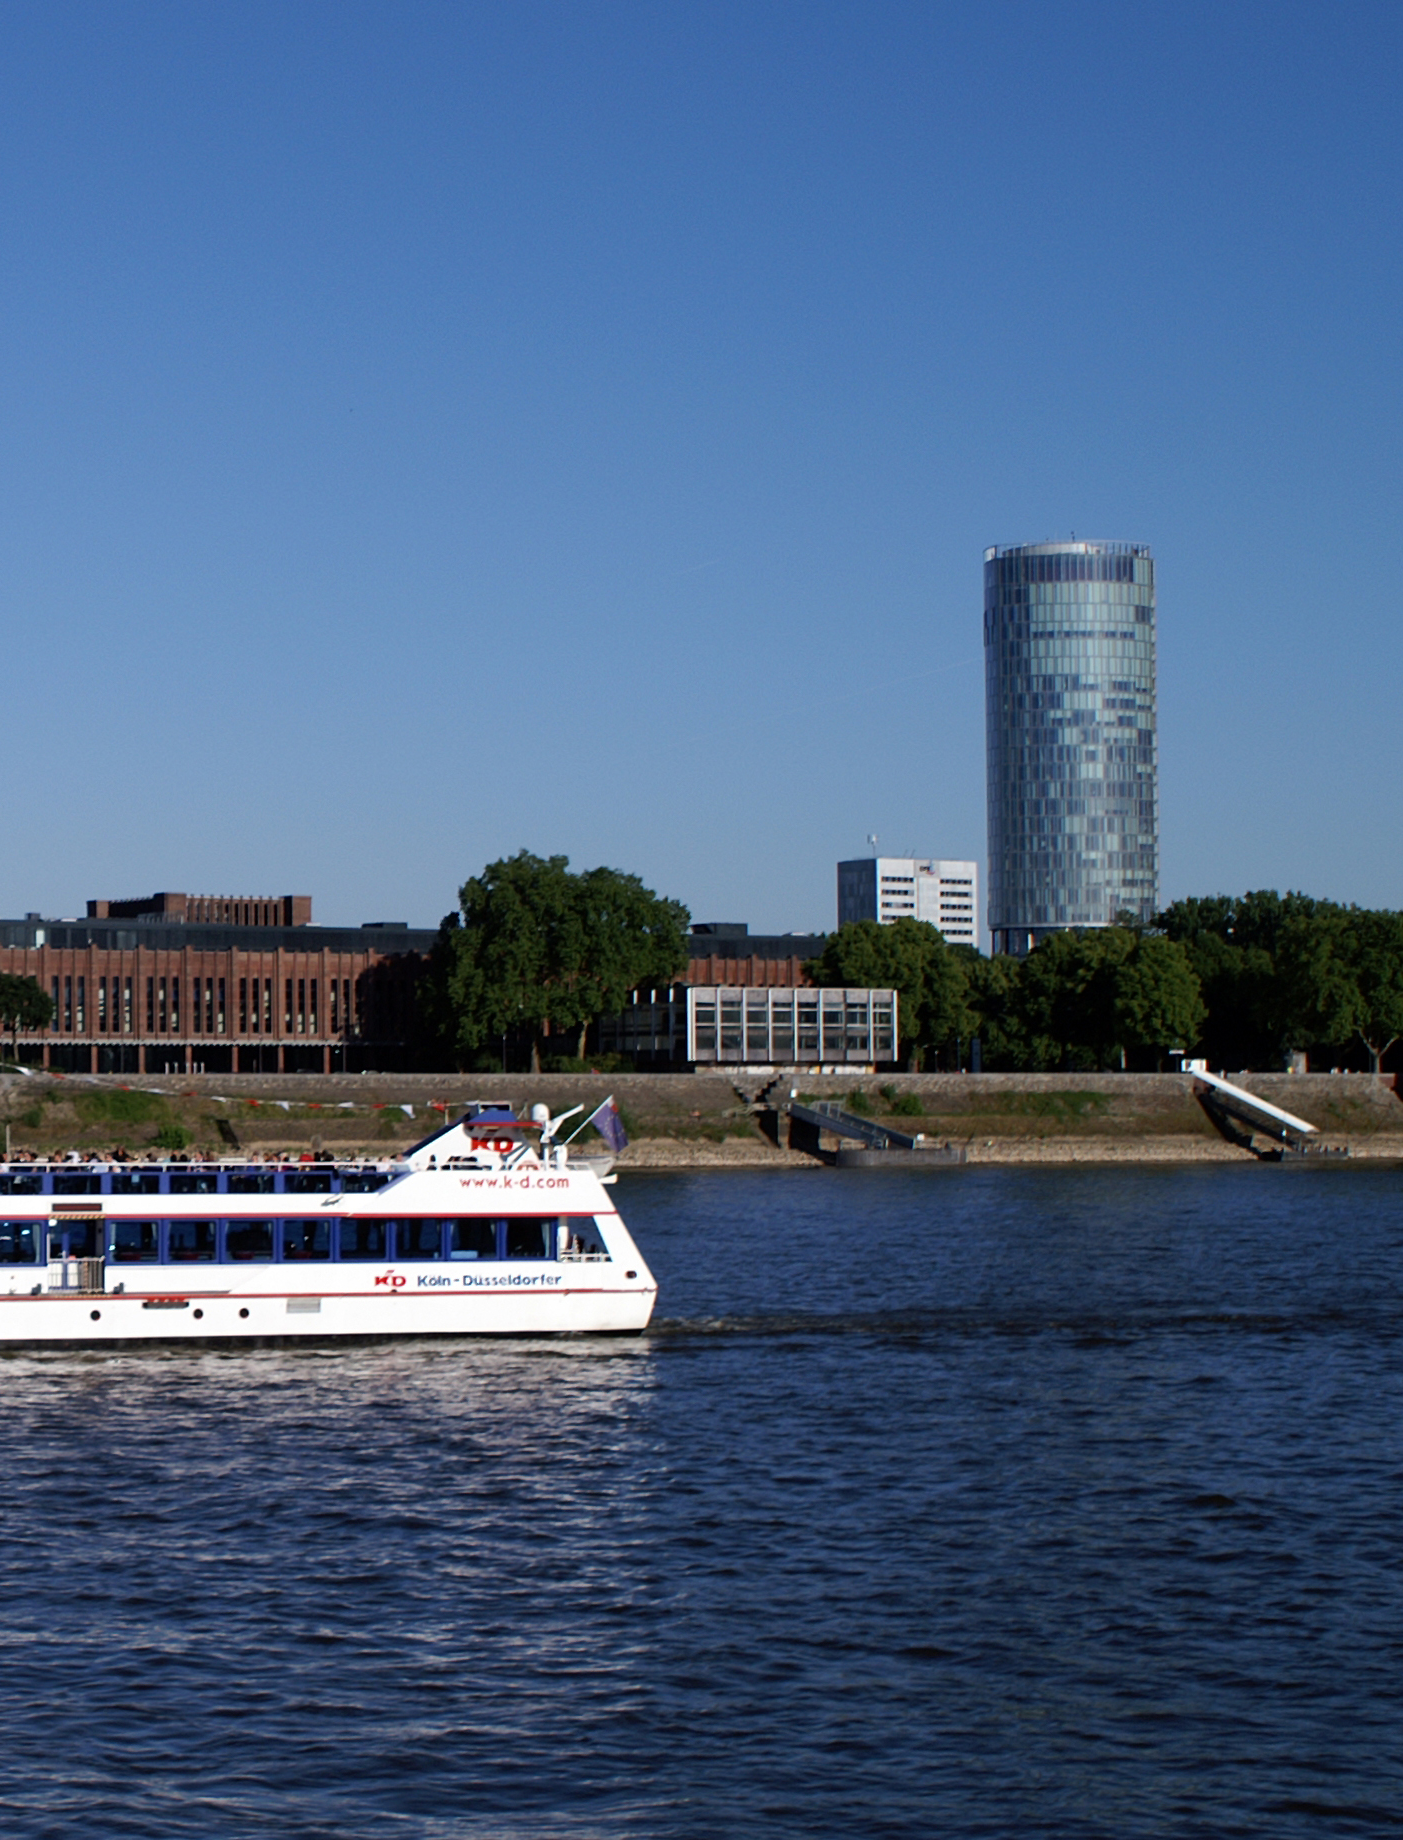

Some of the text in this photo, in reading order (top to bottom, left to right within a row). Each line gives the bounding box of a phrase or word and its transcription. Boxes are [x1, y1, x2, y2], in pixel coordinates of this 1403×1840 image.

[470, 1136, 514, 1153] KD
[460, 1175, 570, 1189] www.k-d.com
[374, 1269, 406, 1287] KD
